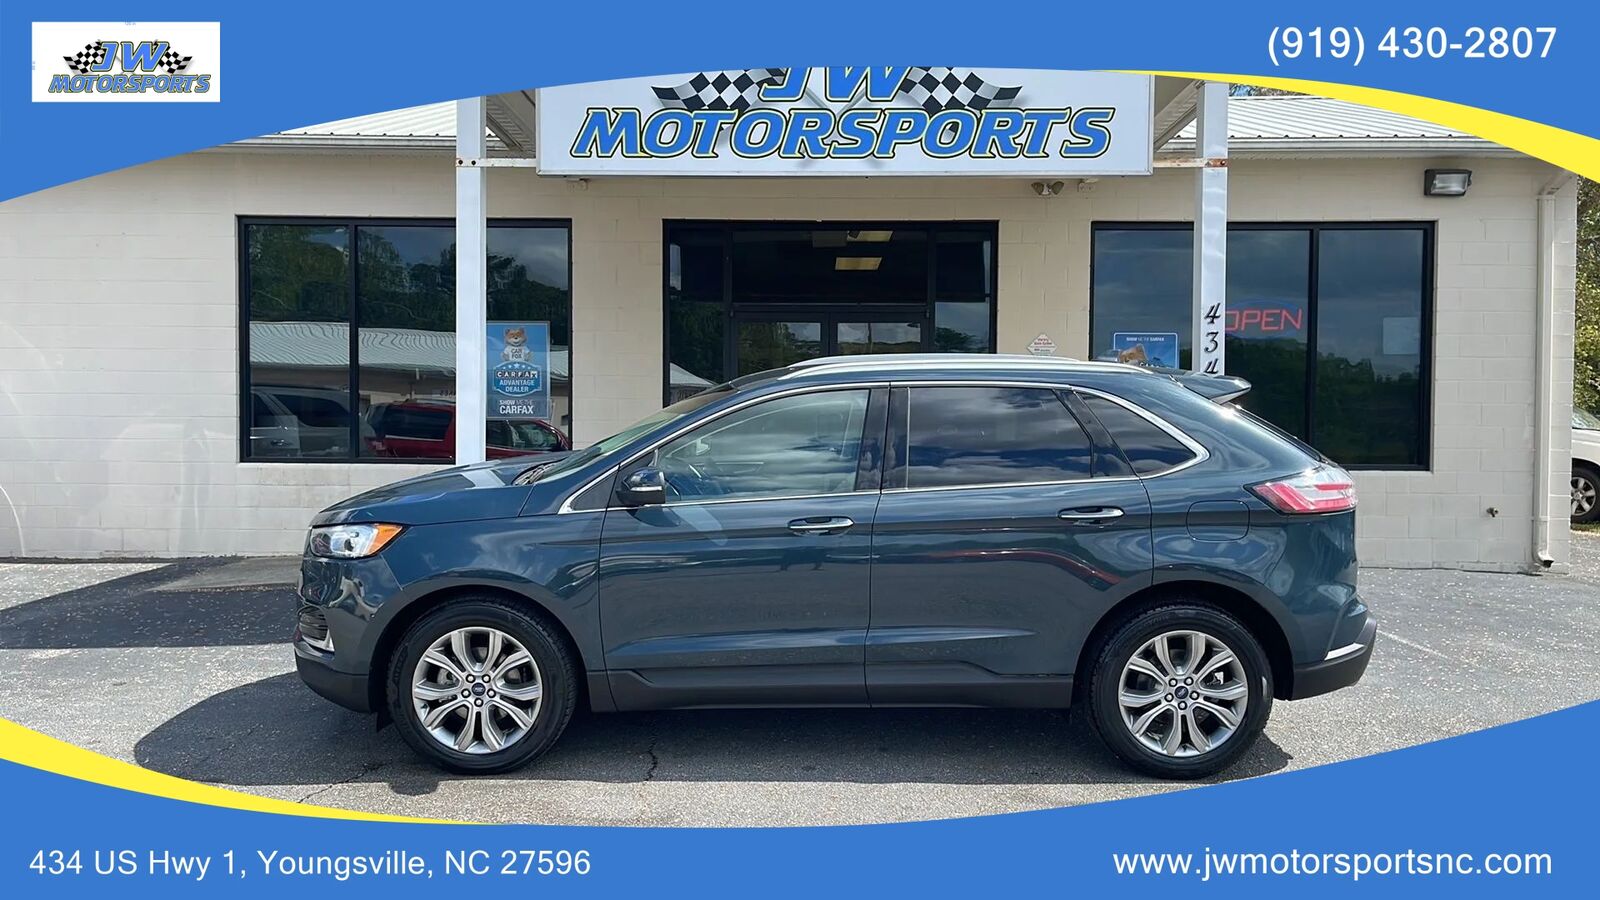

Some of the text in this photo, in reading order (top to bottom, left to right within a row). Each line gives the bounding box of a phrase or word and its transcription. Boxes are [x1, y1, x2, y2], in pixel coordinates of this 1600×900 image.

[570, 107, 1115, 160] MOTORSPORTS
[1225, 308, 1303, 331] OPEN
[499, 405, 534, 414] CARFAX
